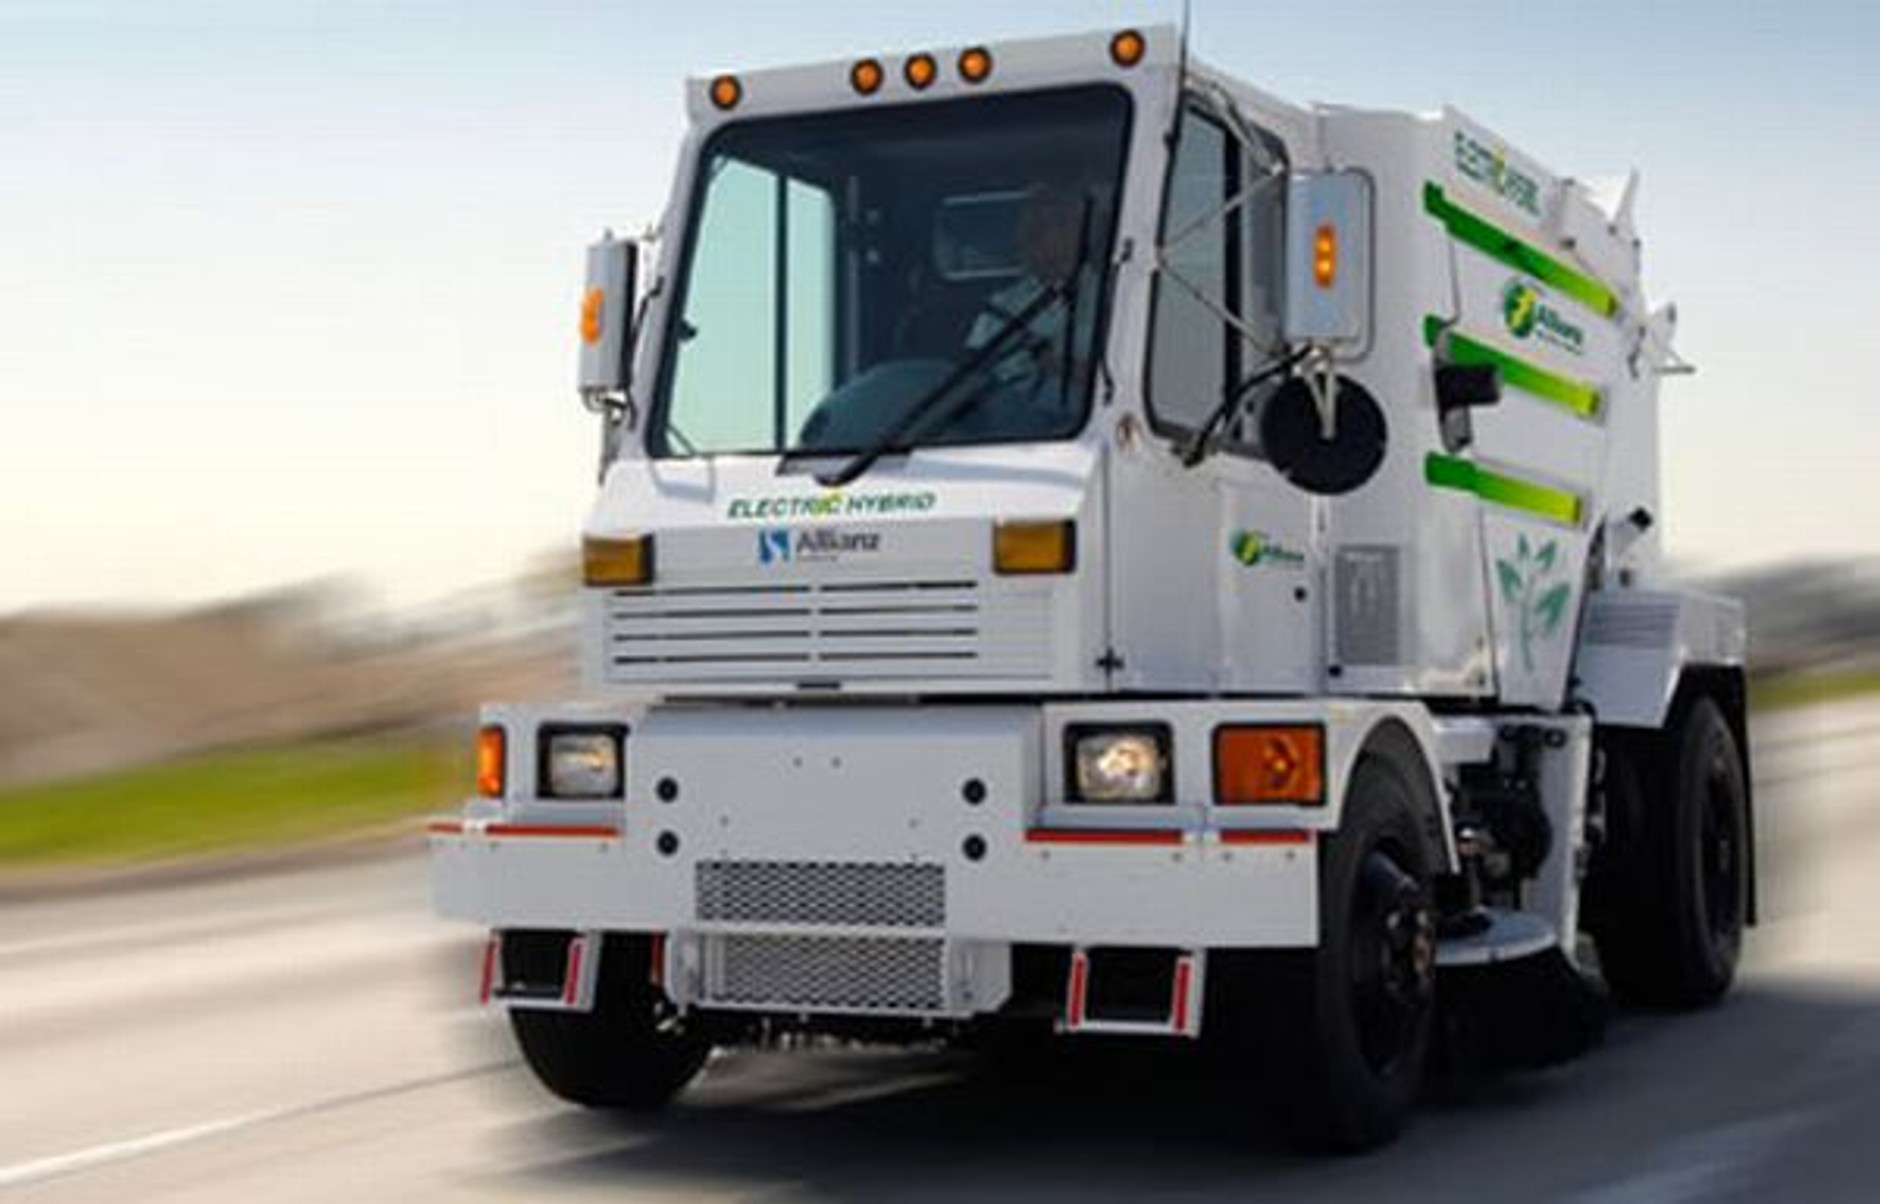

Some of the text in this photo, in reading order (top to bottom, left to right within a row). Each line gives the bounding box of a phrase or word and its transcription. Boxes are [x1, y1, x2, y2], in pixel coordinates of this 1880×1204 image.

[727, 492, 936, 518] ELECTRIC HYBRID
[797, 526, 881, 551] Allianz
